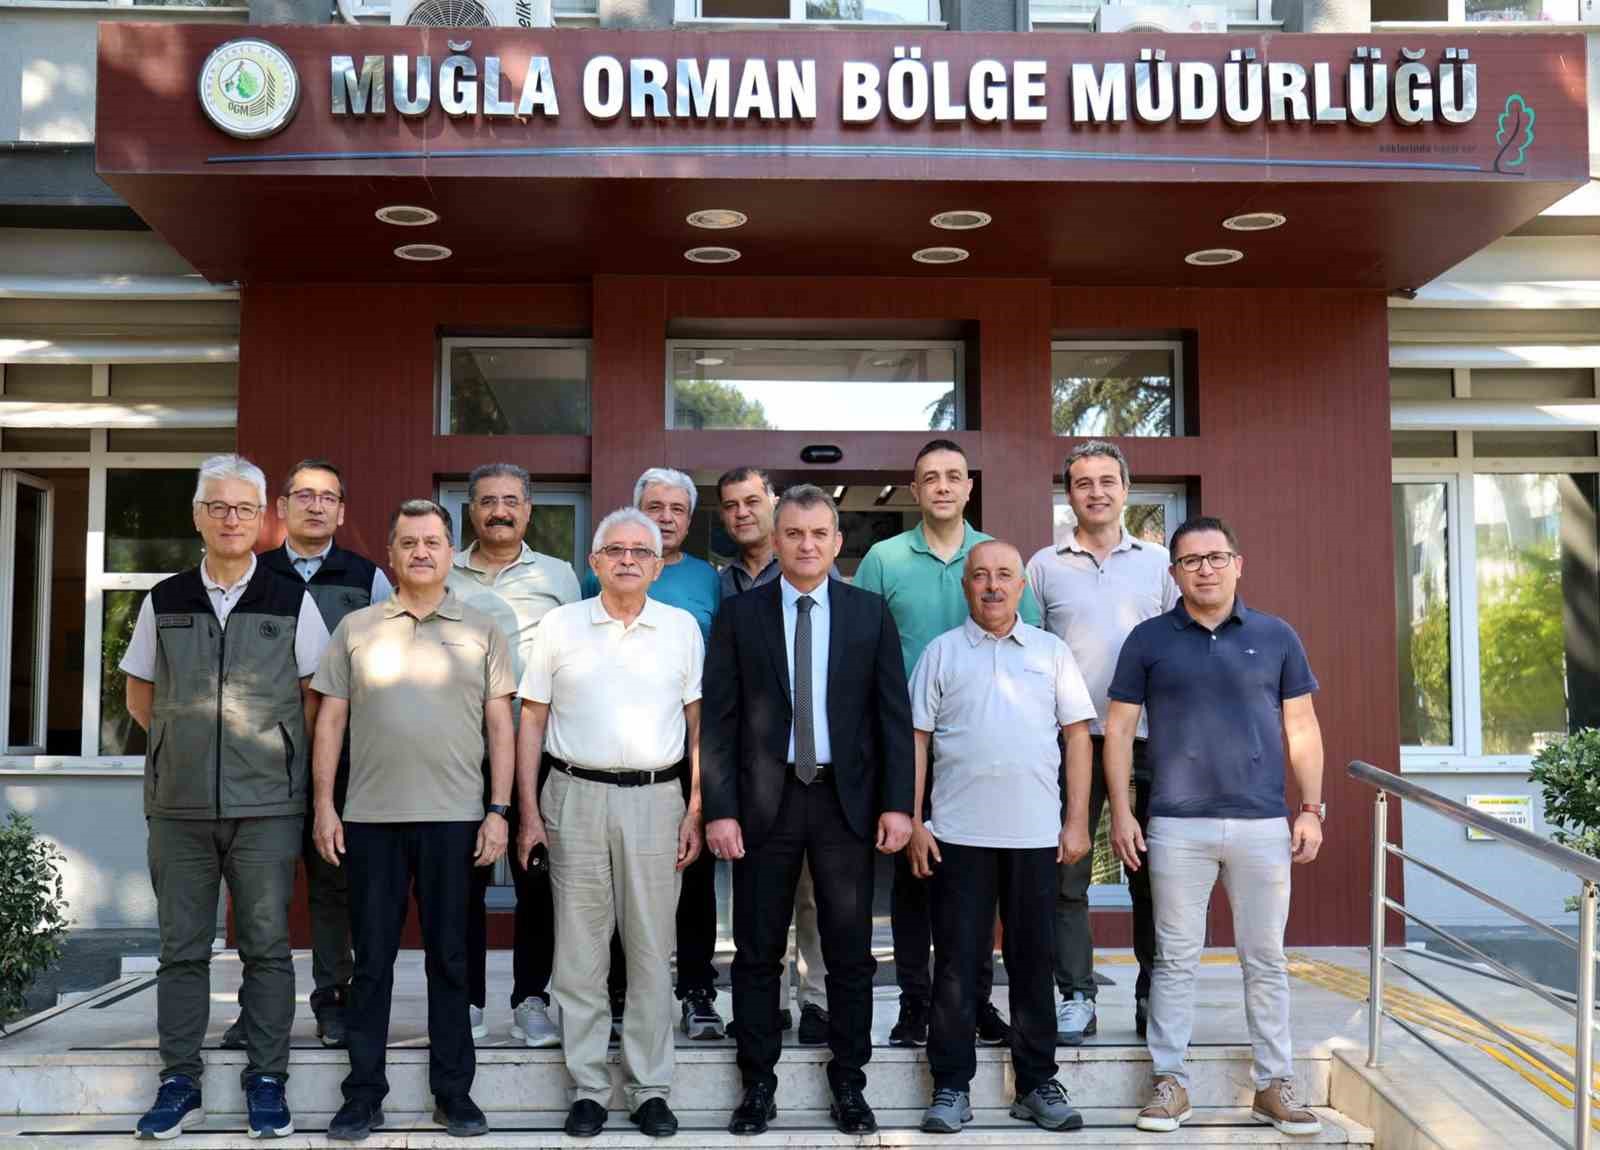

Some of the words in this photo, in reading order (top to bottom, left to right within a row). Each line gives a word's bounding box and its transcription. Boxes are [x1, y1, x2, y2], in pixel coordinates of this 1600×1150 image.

[515, 0, 532, 28] elik
[330, 41, 559, 119] MUĞLA
[583, 56, 817, 122] ORMAN
[841, 46, 1048, 125] BÖLGE
[1072, 46, 1479, 126] MÜDÜRLÜĞÜ
